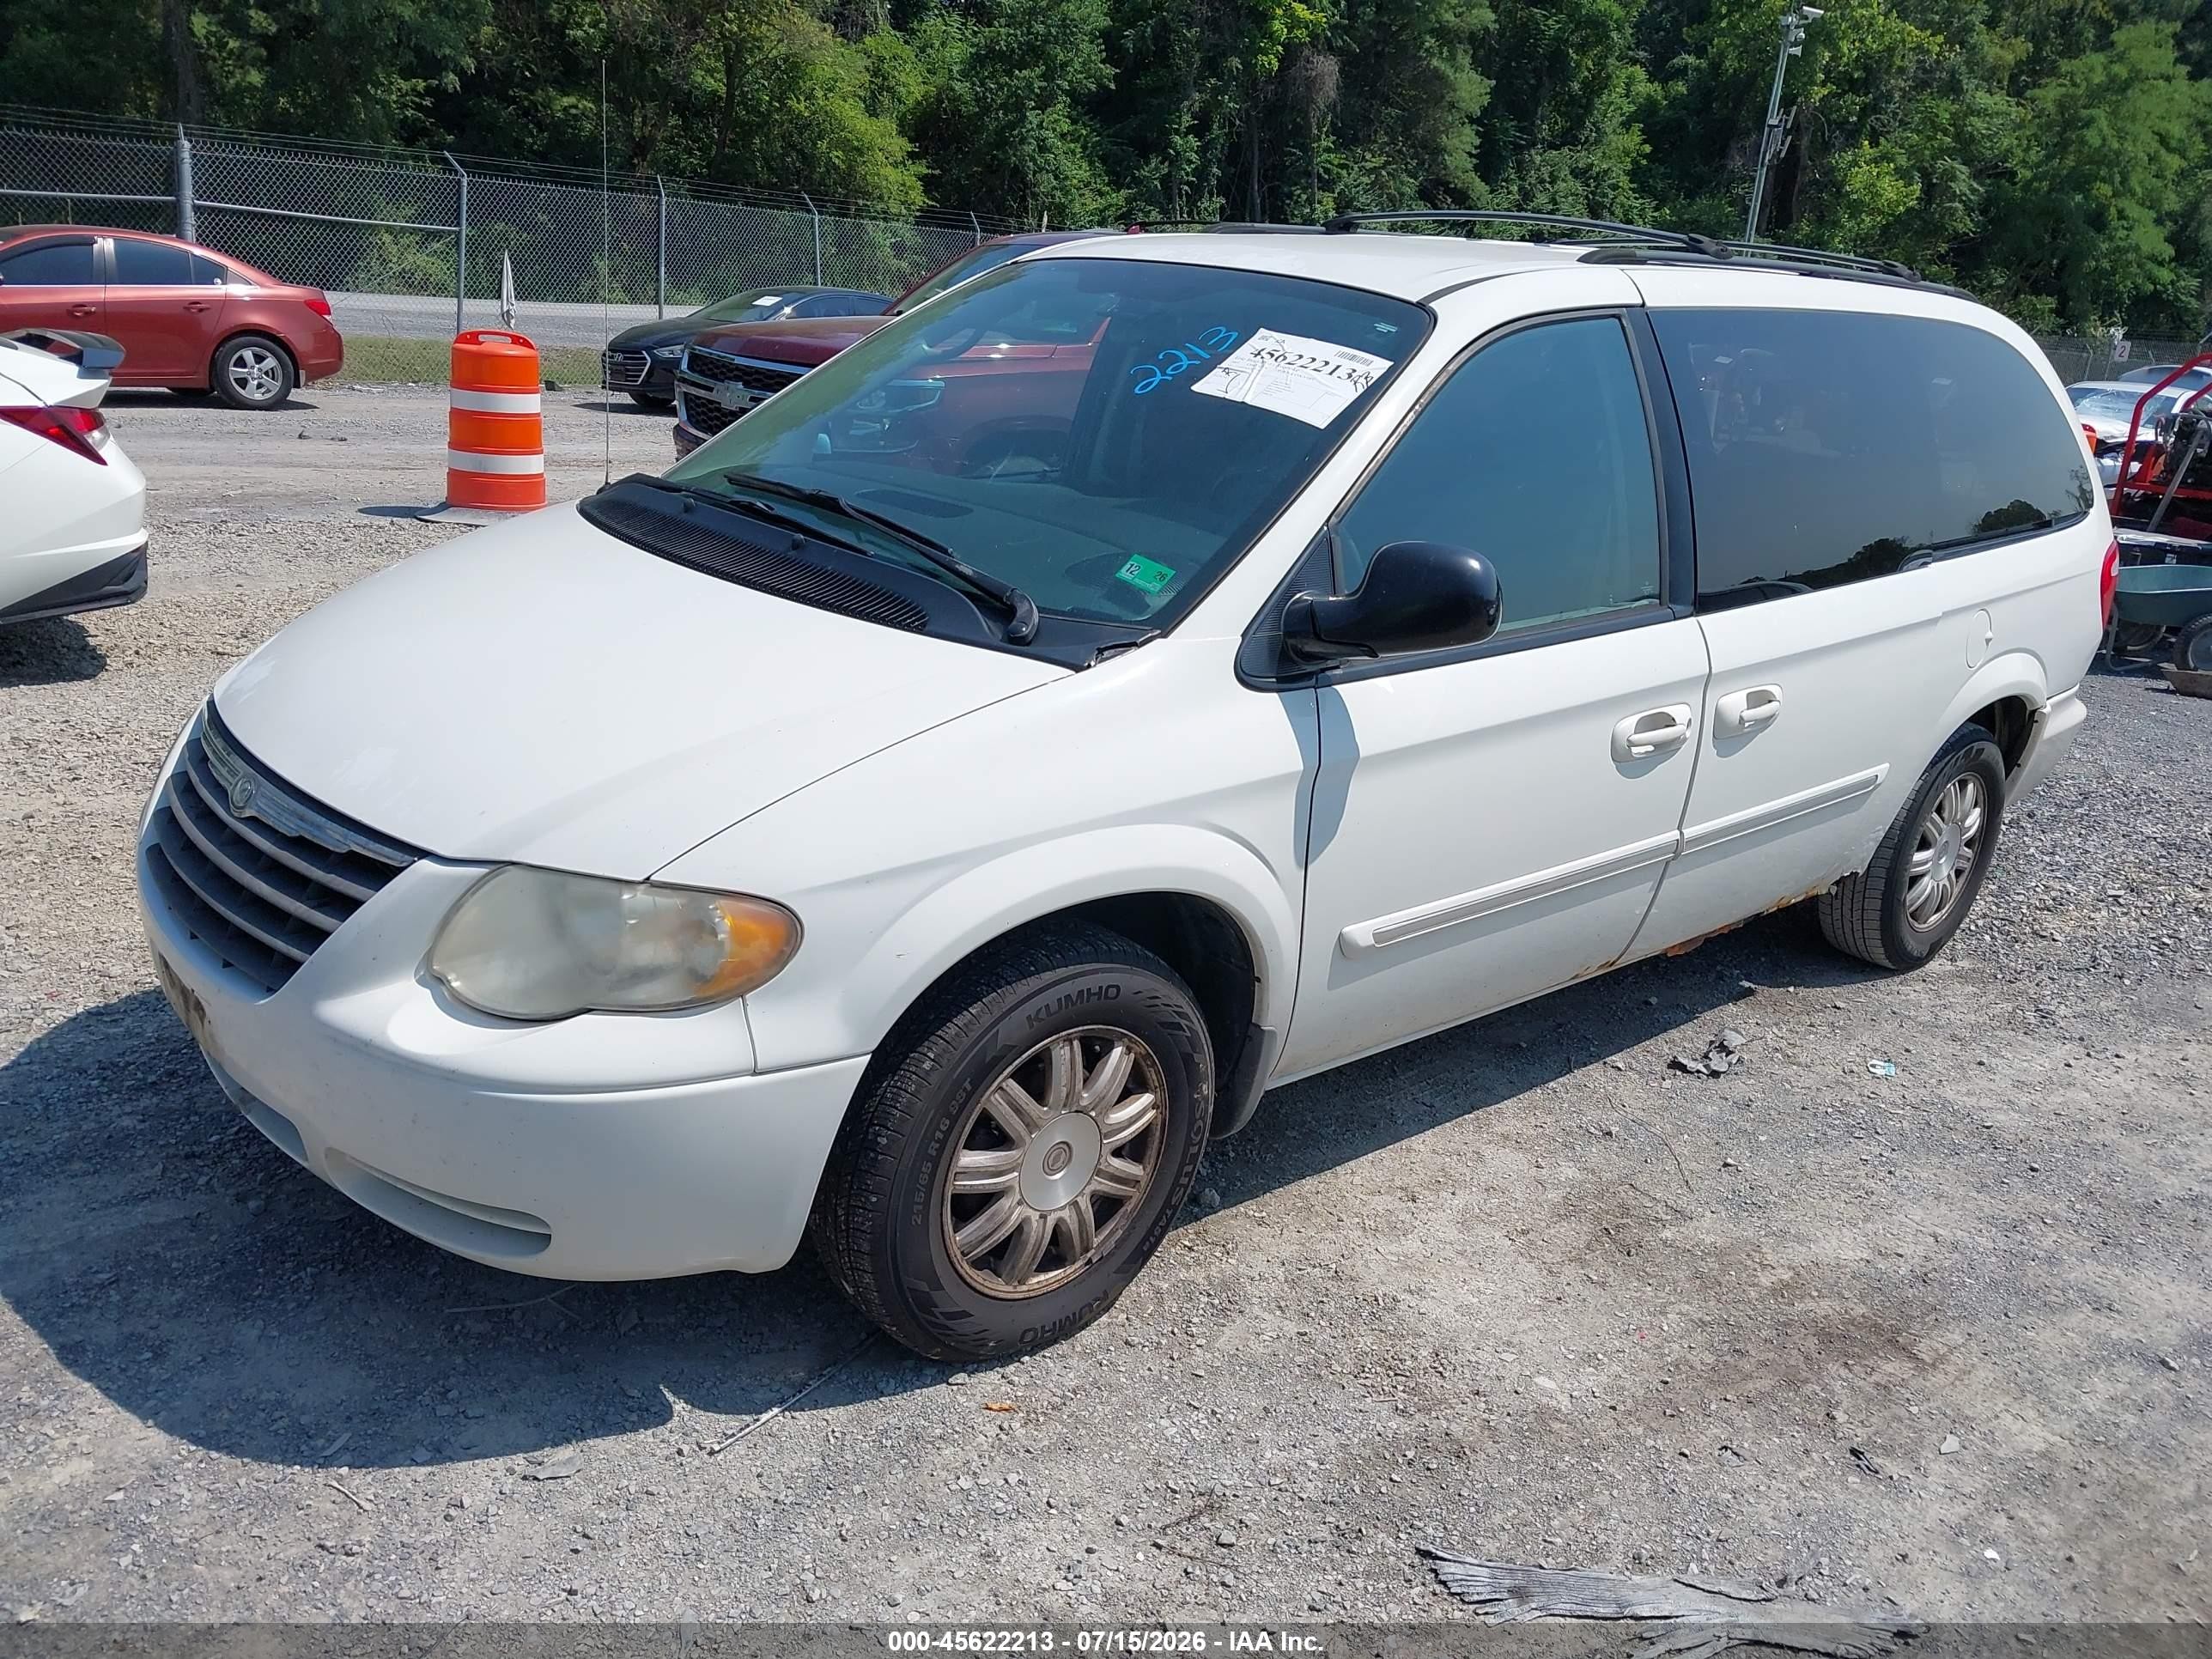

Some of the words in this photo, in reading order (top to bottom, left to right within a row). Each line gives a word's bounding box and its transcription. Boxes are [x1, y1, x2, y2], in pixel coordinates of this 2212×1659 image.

[1130, 326, 1239, 394] 2213
[1250, 348, 1357, 380] 45622213
[2118, 345, 2126, 357] 2
[1126, 563, 1140, 576] 12
[1026, 984, 1121, 1030] KUMHO
[911, 1161, 933, 1225] 215/65
[927, 1117, 951, 1157] R16
[1171, 1101, 1203, 1205] SOLUS
